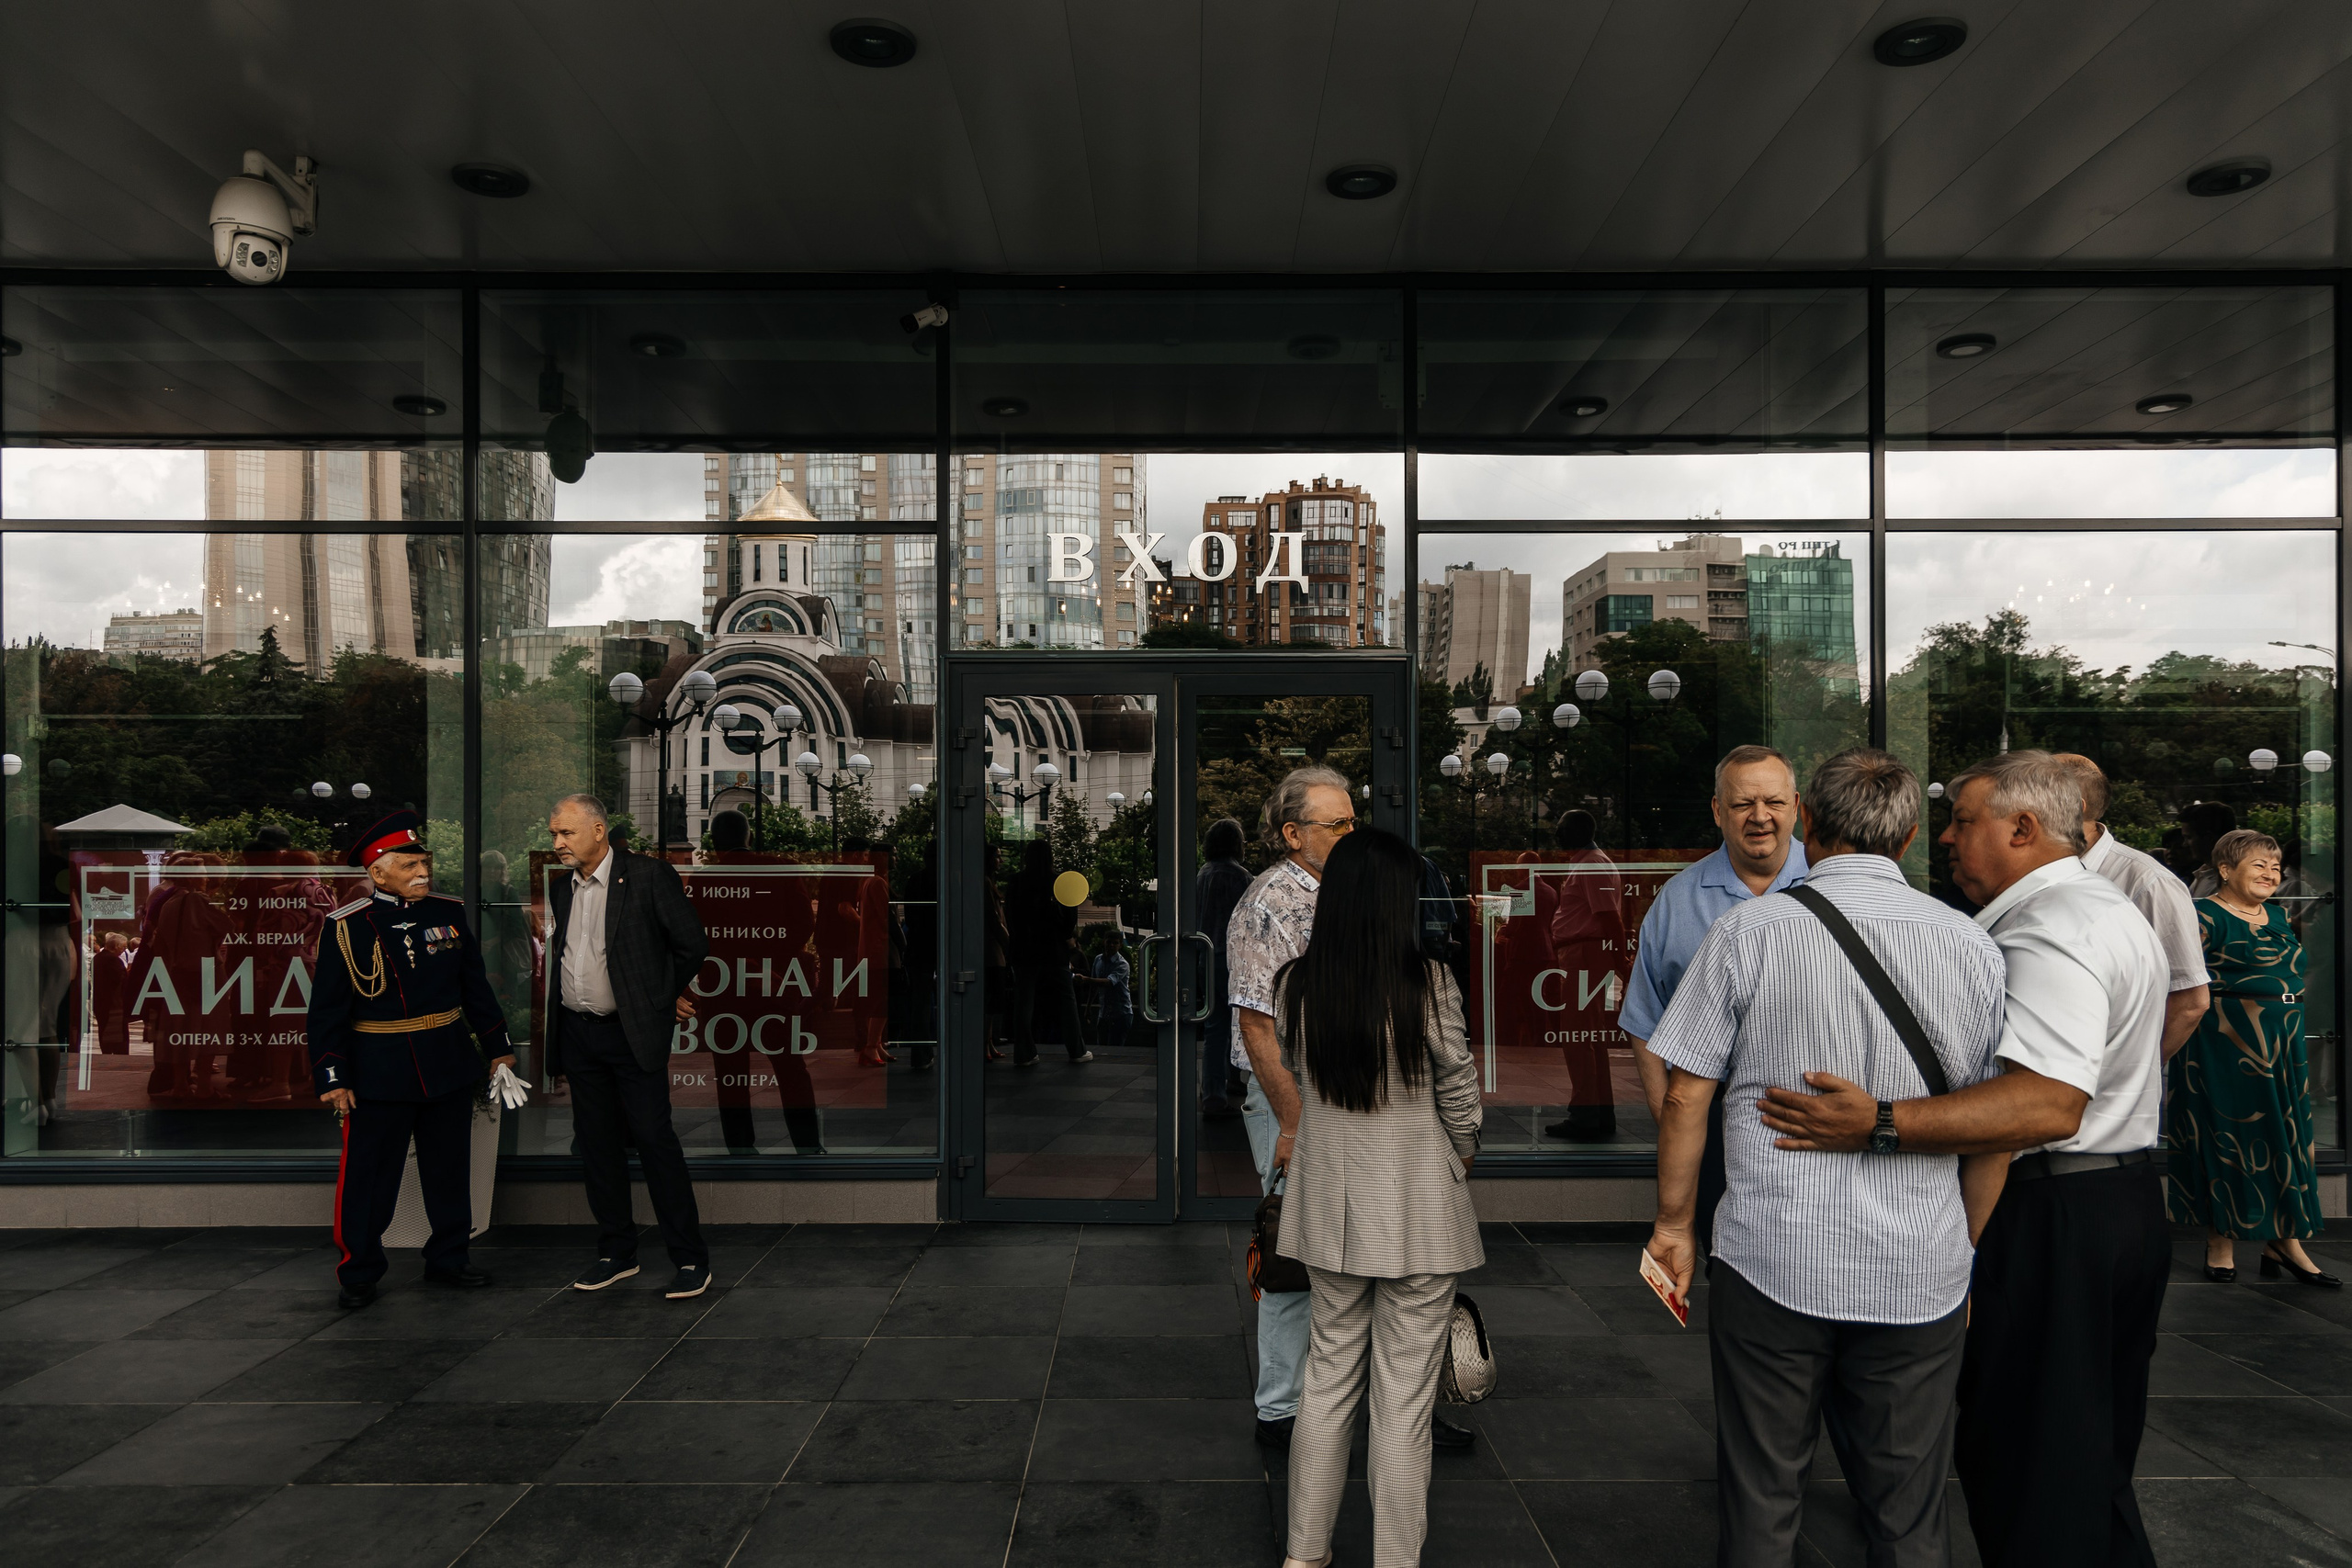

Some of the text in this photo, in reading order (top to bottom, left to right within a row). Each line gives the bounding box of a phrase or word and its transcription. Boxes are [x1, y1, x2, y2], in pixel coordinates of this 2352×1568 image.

[1046, 532, 1309, 594] ВХОД
[684, 886, 751, 898] 2 ИЮНЯ
[1624, 884, 1640, 897] 21
[229, 897, 307, 910] 29 ИЮНЯ
[222, 932, 305, 945] ДЖ. ВЕРДИ
[705, 927, 787, 939] БНИКОВ
[1601, 939, 1619, 951] И.
[689, 956, 868, 998] ОНА И
[131, 956, 312, 1017] АИД
[1531, 968, 1615, 1011] СИ
[168, 1030, 309, 1045] ОПЕРА В 3-Х ДЕЙС
[672, 1013, 818, 1055] ВОСЬ
[1544, 1030, 1628, 1043] ОПЕРЕТТА
[673, 1074, 707, 1087] РОК
[722, 1074, 779, 1087] ОПЕРА
